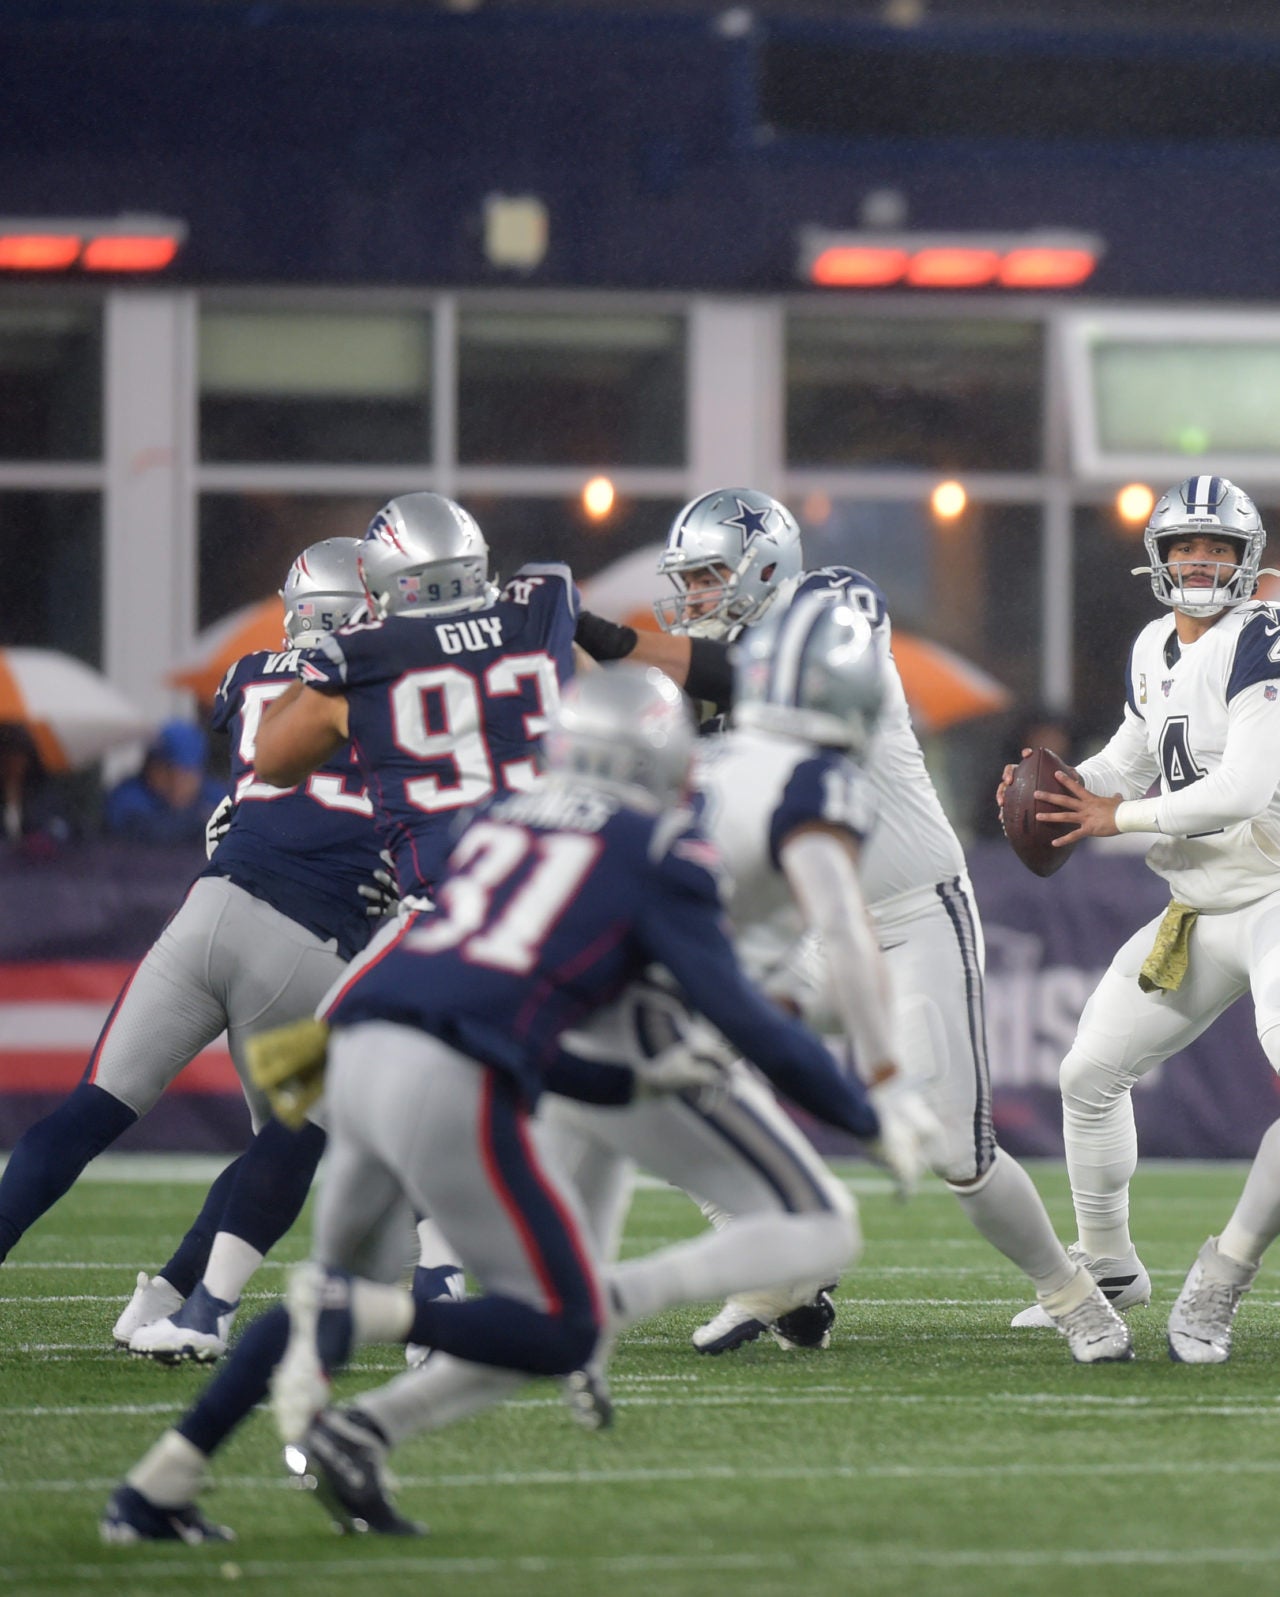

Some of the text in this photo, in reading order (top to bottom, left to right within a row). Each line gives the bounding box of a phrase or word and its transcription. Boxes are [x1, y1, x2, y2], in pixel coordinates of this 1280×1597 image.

[428, 579, 462, 602] 93
[435, 616, 503, 655] GUY
[388, 651, 564, 815] 93
[402, 816, 606, 978] 31
